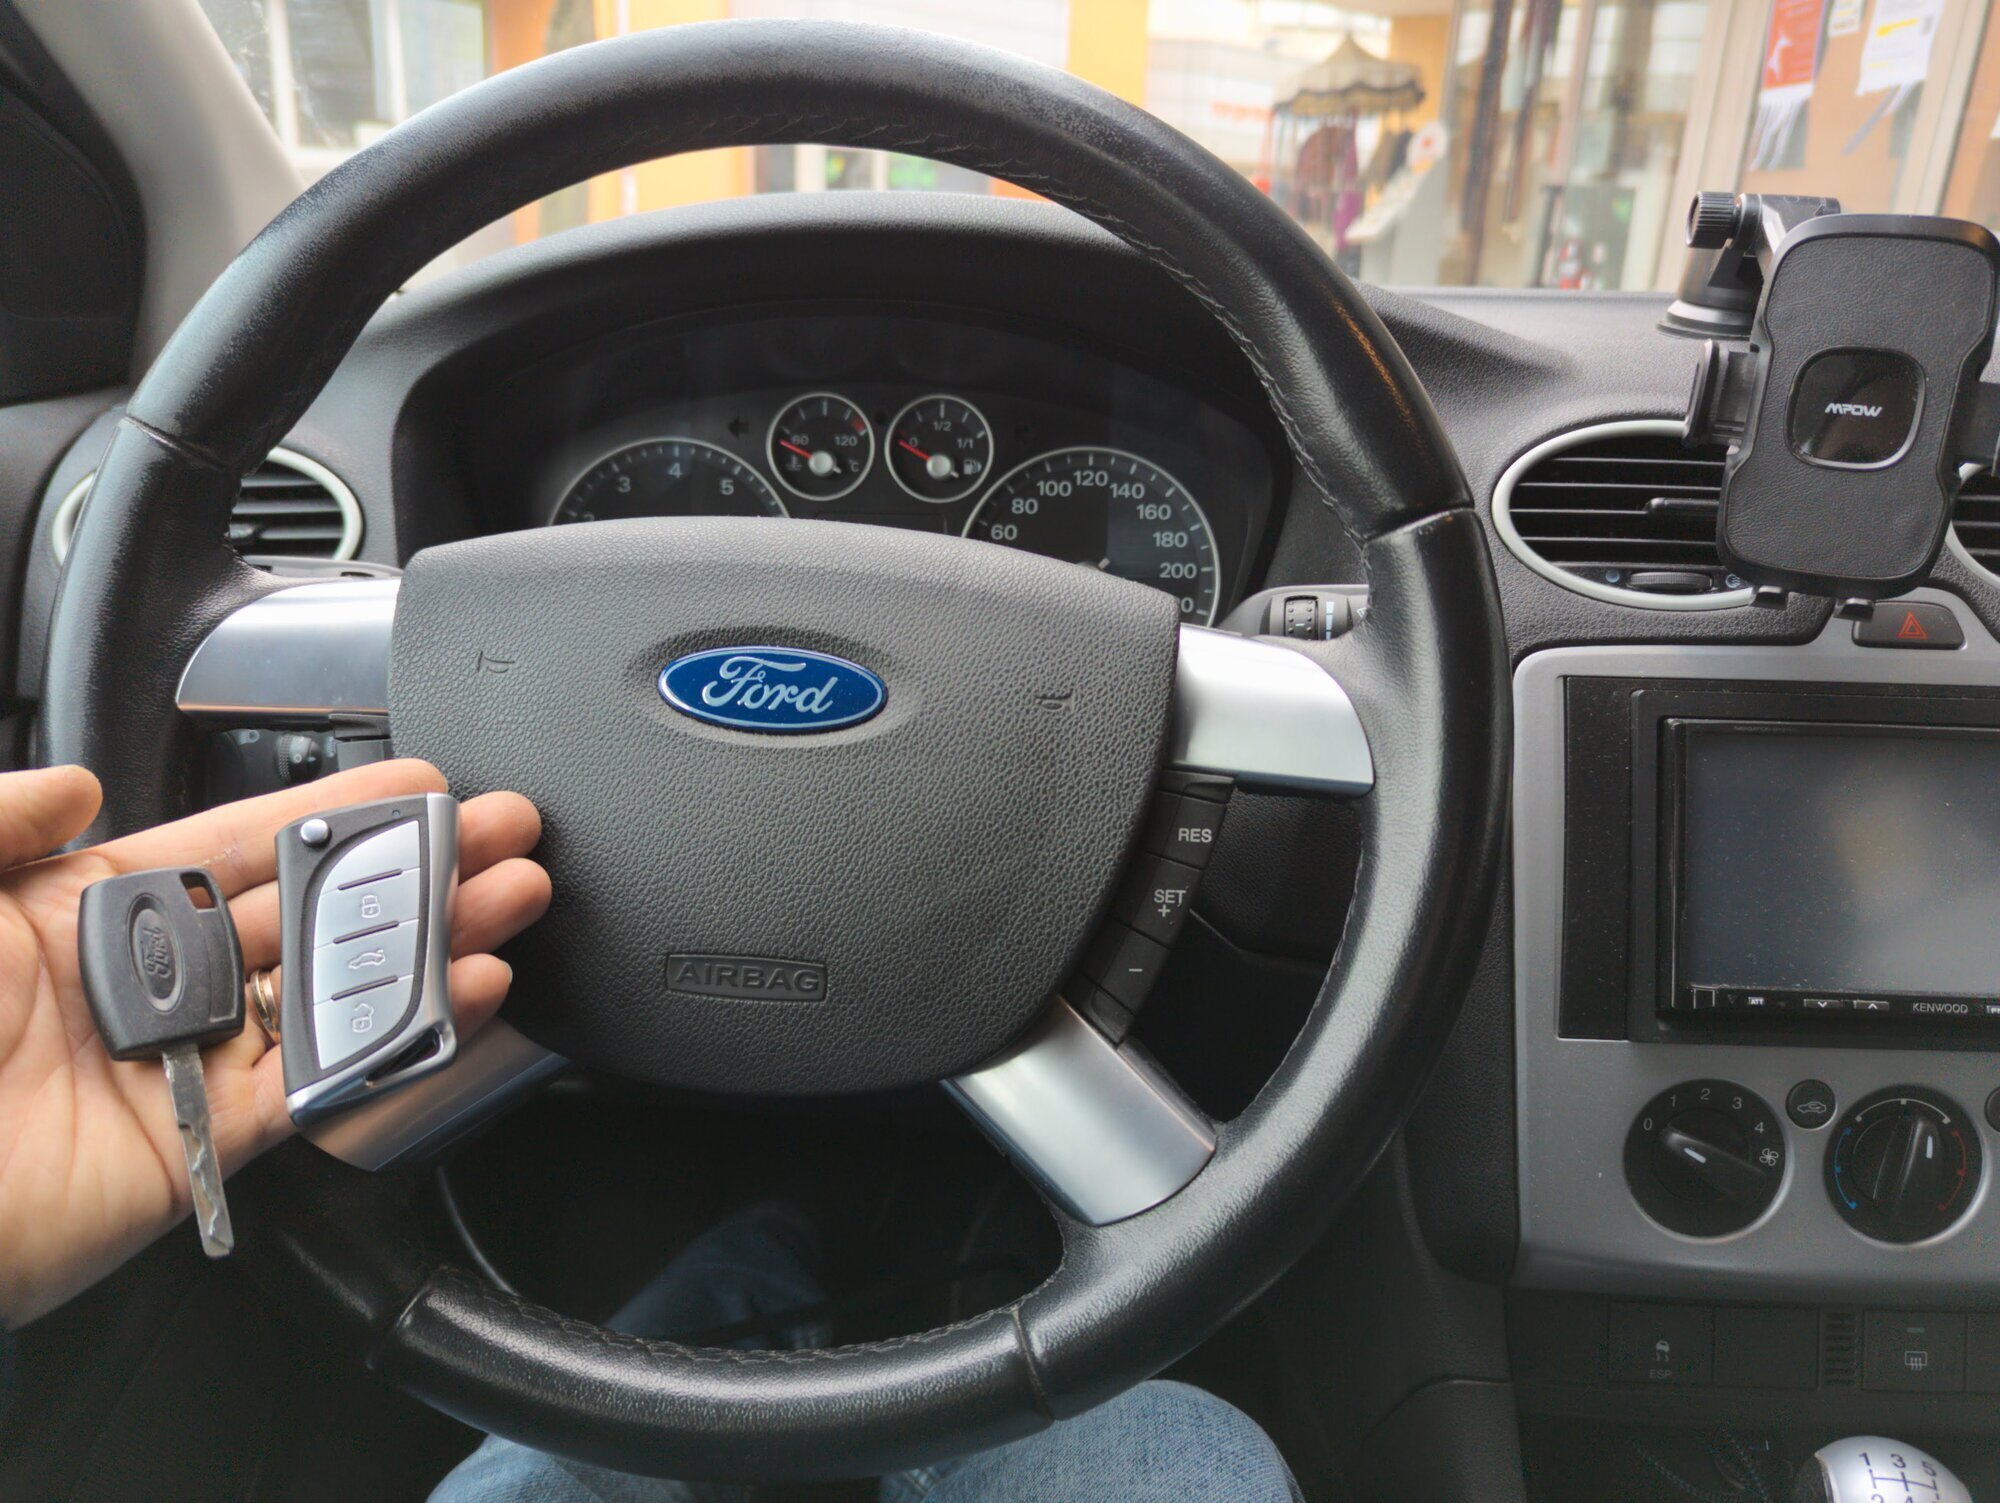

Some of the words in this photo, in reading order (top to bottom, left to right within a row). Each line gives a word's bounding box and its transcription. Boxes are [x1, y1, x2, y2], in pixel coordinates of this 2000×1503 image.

[1824, 402, 1883, 417] MPOW
[933, 421, 952, 432] 1/2
[834, 435, 858, 447] 120
[957, 438, 974, 449] 1/1
[667, 462, 683, 478] 4
[617, 476, 631, 493] 3
[1073, 470, 1109, 487] 120
[720, 479, 735, 495] 5
[1037, 480, 1072, 497] 100
[1110, 483, 1145, 499] 140
[1011, 498, 1039, 515] 80
[1136, 504, 1172, 520] 160
[990, 524, 1018, 541] 60
[1153, 531, 1188, 548] 180
[1159, 562, 1197, 579] 200
[702, 656, 838, 714] Ford
[1177, 828, 1213, 843] RES
[1153, 889, 1187, 905] SET
[140, 926, 171, 978] Ford
[675, 961, 820, 993] AIRBAG
[1912, 1002, 1968, 1014] KENWOOD
[1670, 1095, 1677, 1108] 1
[1700, 1088, 1711, 1101] 2
[1732, 1097, 1743, 1110] 3
[1643, 1118, 1653, 1131] 0
[1754, 1121, 1765, 1134] 4
[1649, 1369, 1673, 1379] ESP
[1858, 1452, 1870, 1466] 1
[1890, 1453, 1907, 1469] 3
[1921, 1460, 1937, 1477] 5
